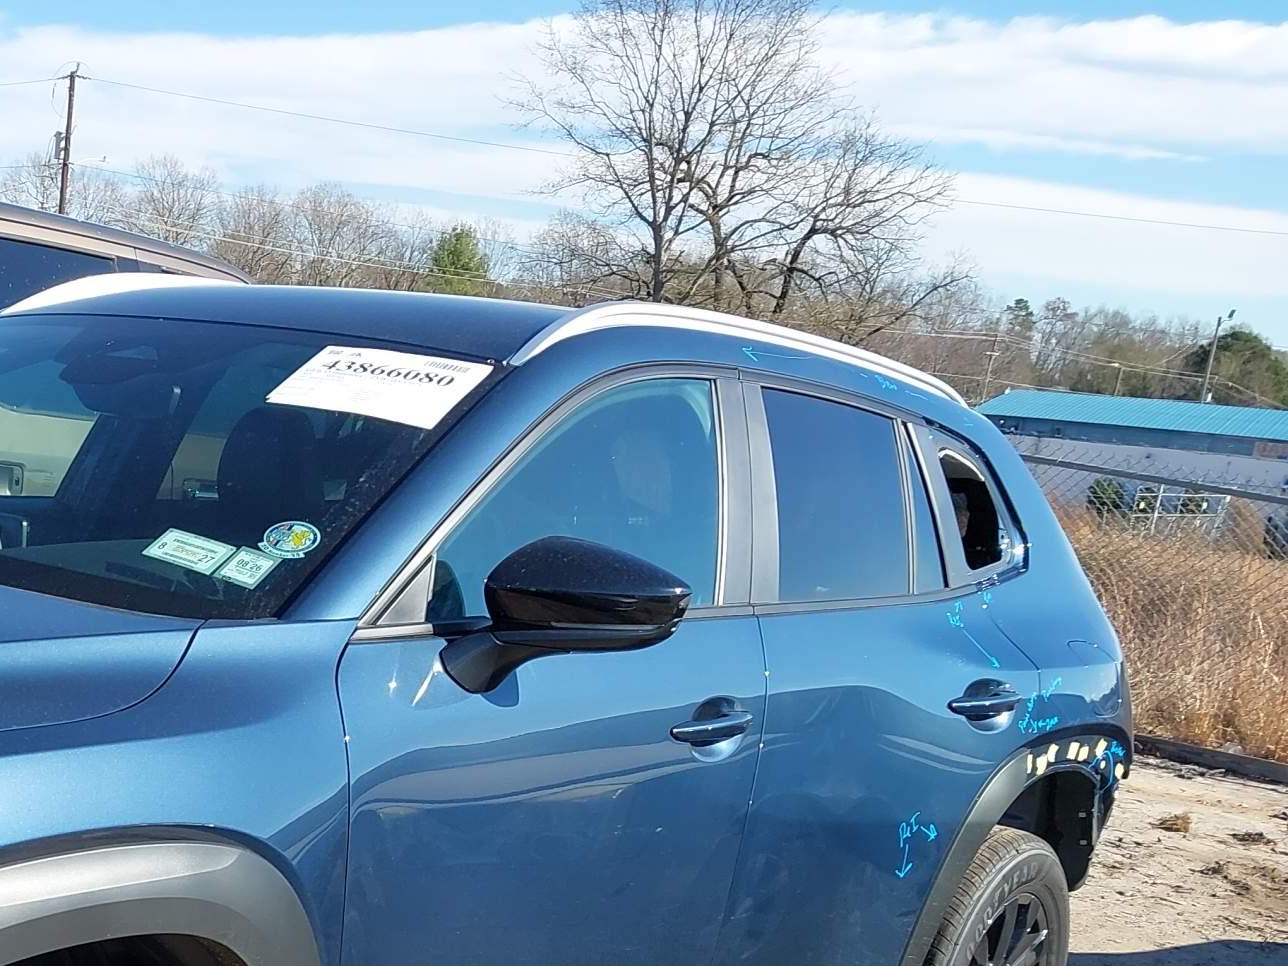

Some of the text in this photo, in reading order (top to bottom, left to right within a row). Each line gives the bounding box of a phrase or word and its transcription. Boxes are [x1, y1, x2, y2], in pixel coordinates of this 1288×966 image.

[322, 359, 455, 387] 43866080
[197, 554, 215, 564] 27
[236, 558, 263, 572] 08 26
